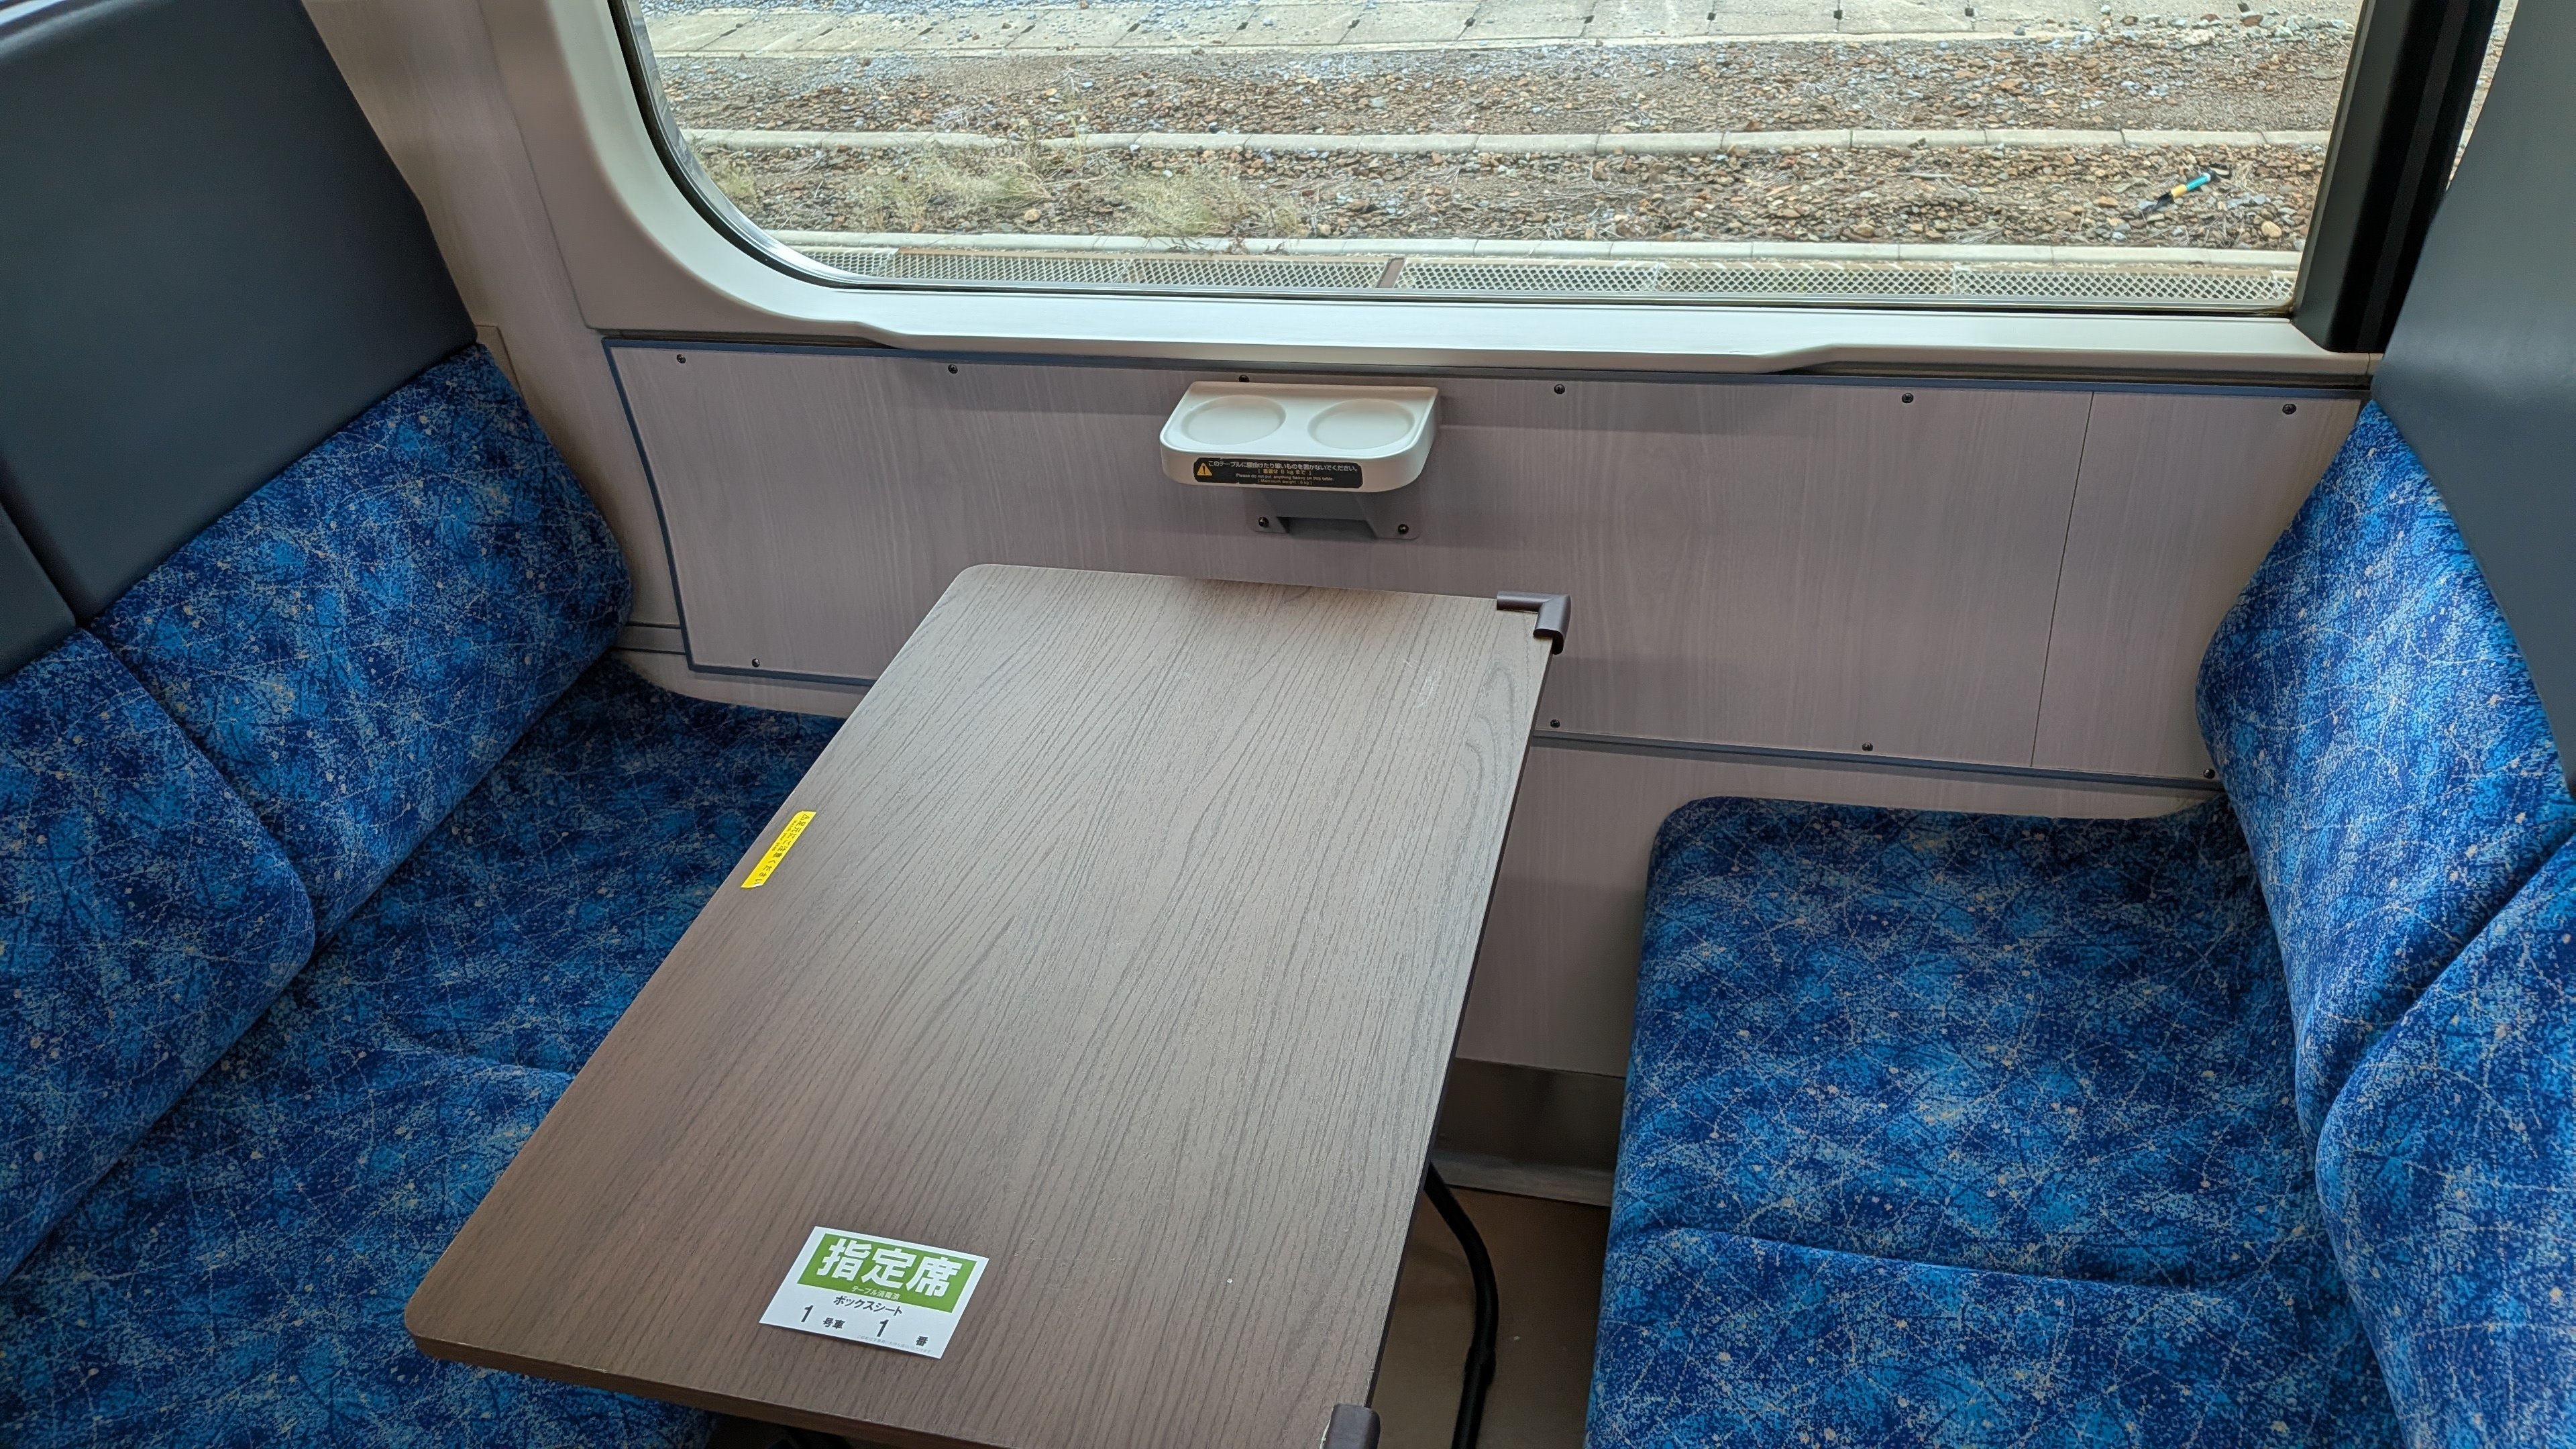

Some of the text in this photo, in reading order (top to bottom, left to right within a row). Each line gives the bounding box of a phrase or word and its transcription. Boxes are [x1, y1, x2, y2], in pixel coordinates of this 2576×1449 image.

[754, 821, 806, 884] 足元にご注意ください
[816, 1238, 962, 1298] 指定席
[833, 1295, 903, 1316] ボックスシート
[851, 1285, 901, 1301] テーブル消毒済
[801, 1304, 814, 1323] 1
[822, 1317, 846, 1330] 号車
[876, 1319, 890, 1337] 1
[915, 1336, 928, 1347] 番
